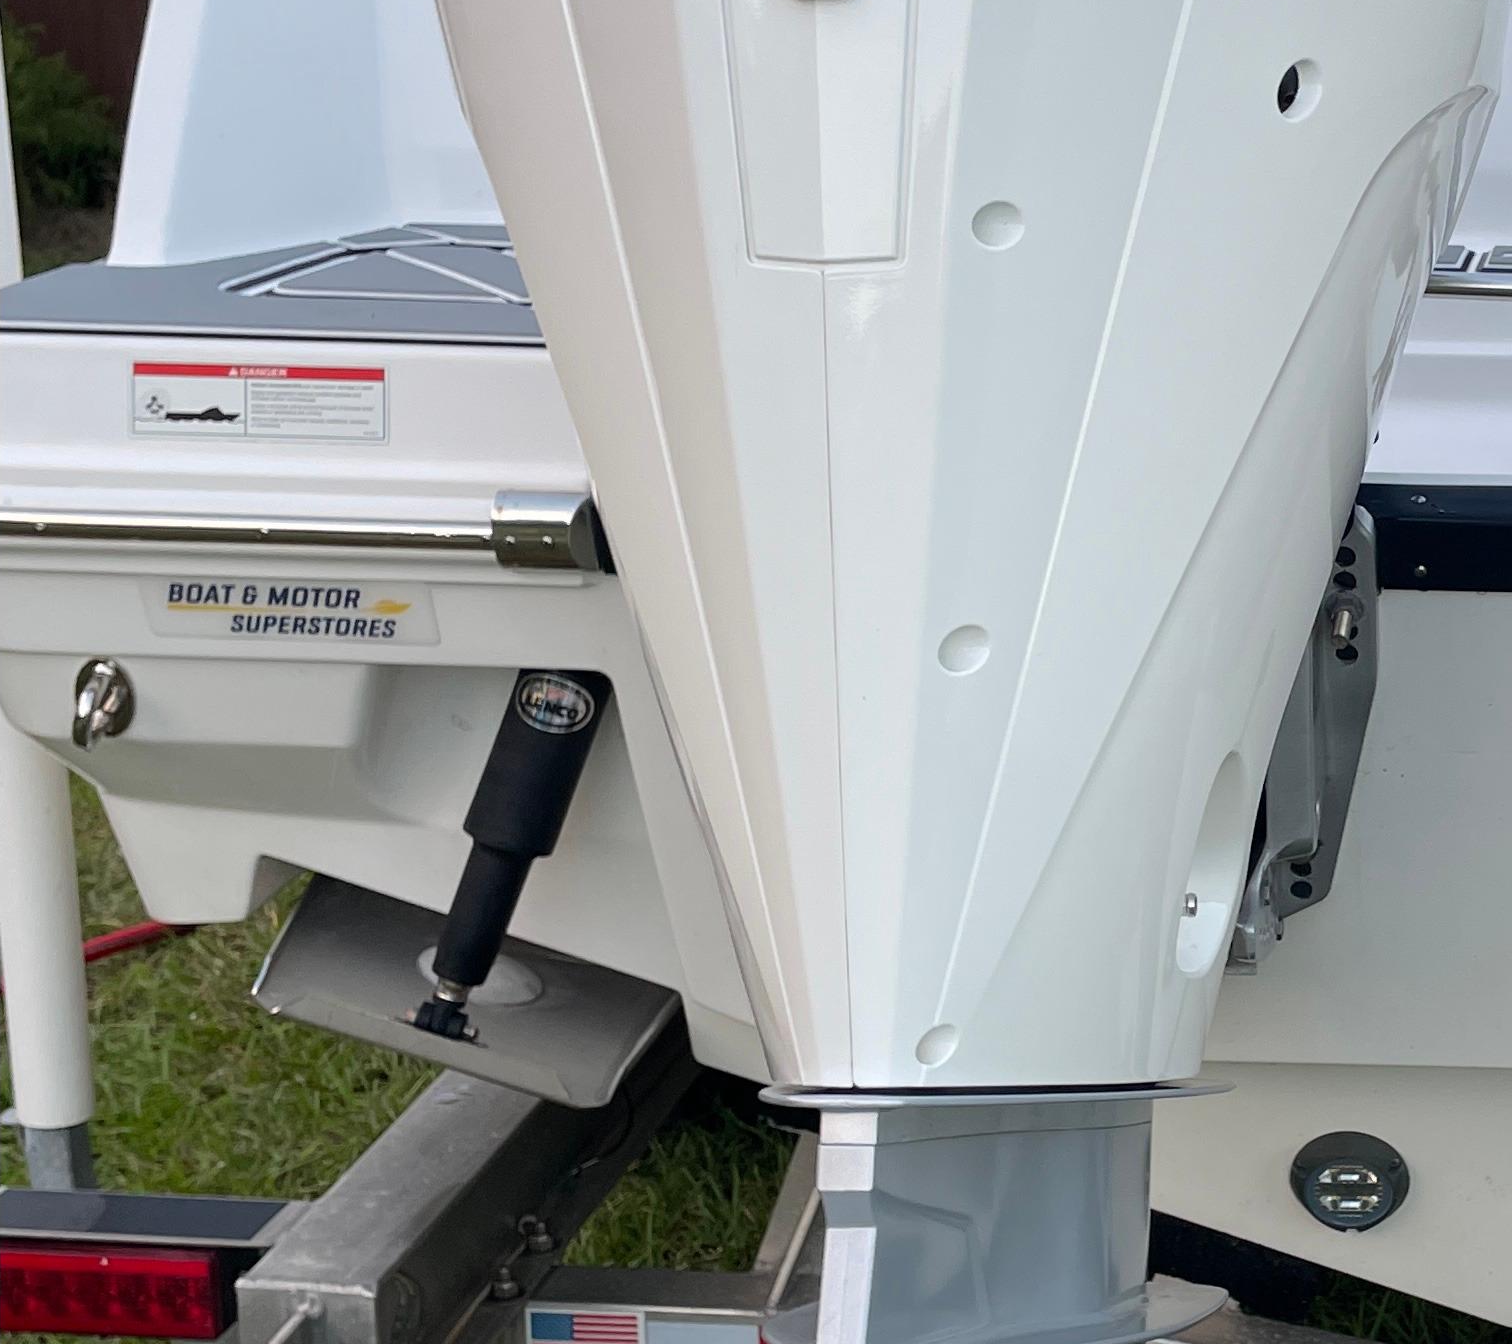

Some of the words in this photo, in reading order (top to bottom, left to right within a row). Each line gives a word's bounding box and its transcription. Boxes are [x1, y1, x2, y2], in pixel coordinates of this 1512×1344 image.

[168, 583, 236, 605] BOAT
[242, 585, 257, 605] &
[267, 586, 361, 609] MOTOR
[230, 614, 397, 639] SUPERSTORES
